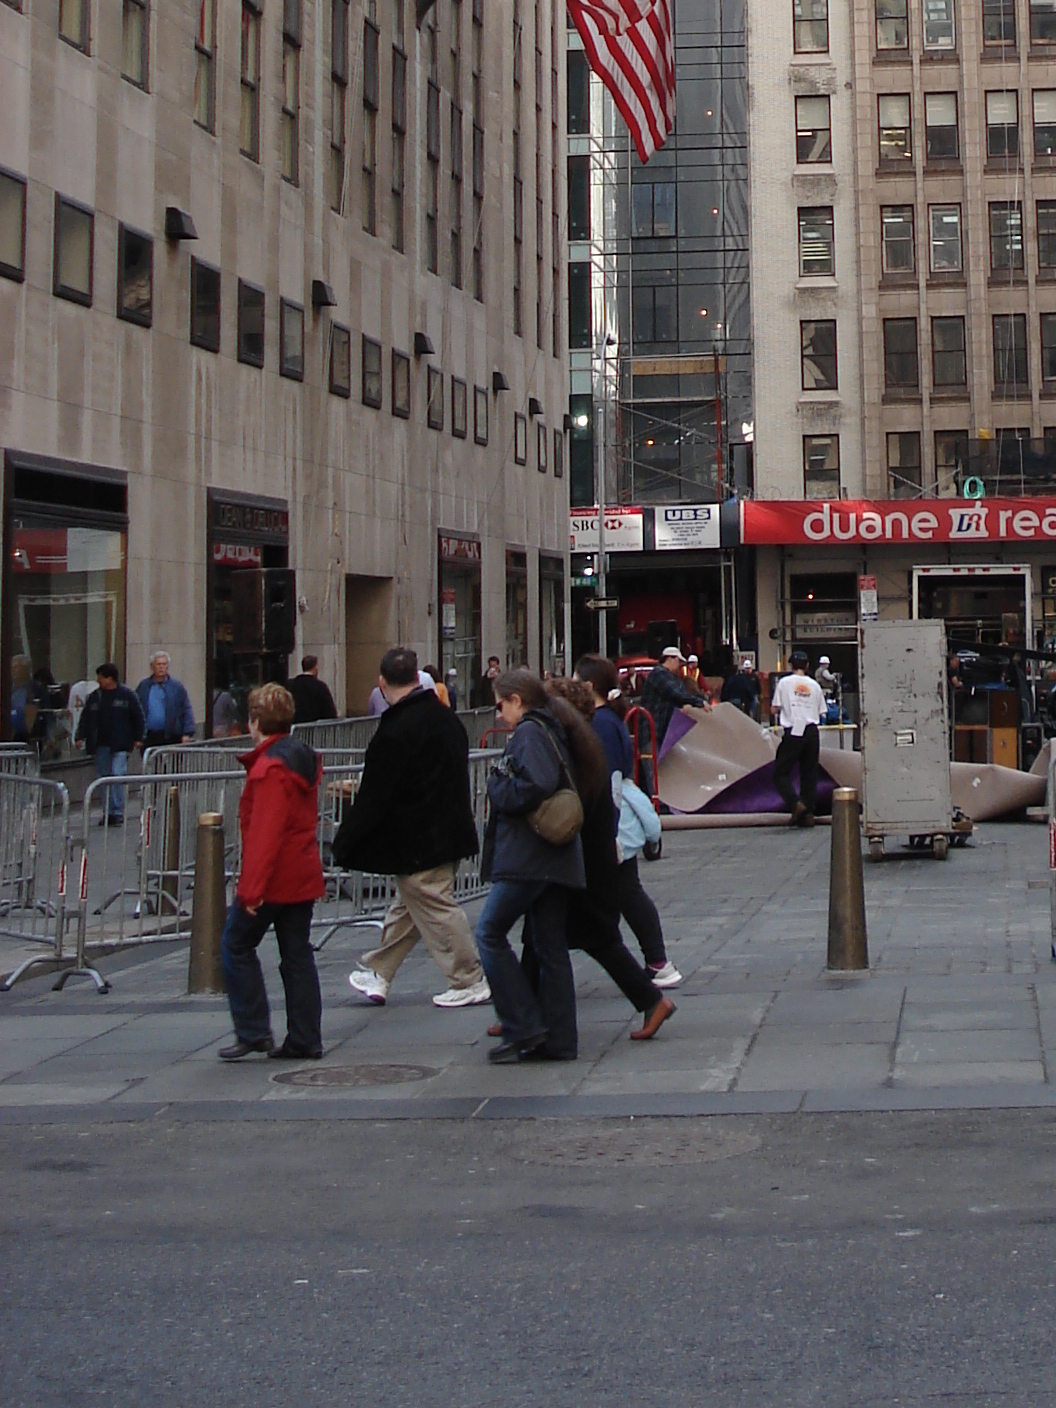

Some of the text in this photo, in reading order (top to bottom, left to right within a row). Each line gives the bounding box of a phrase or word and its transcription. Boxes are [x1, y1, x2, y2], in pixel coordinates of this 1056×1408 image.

[666, 508, 710, 521] UBS
[572, 519, 600, 531] SBC
[803, 503, 938, 541] duane
